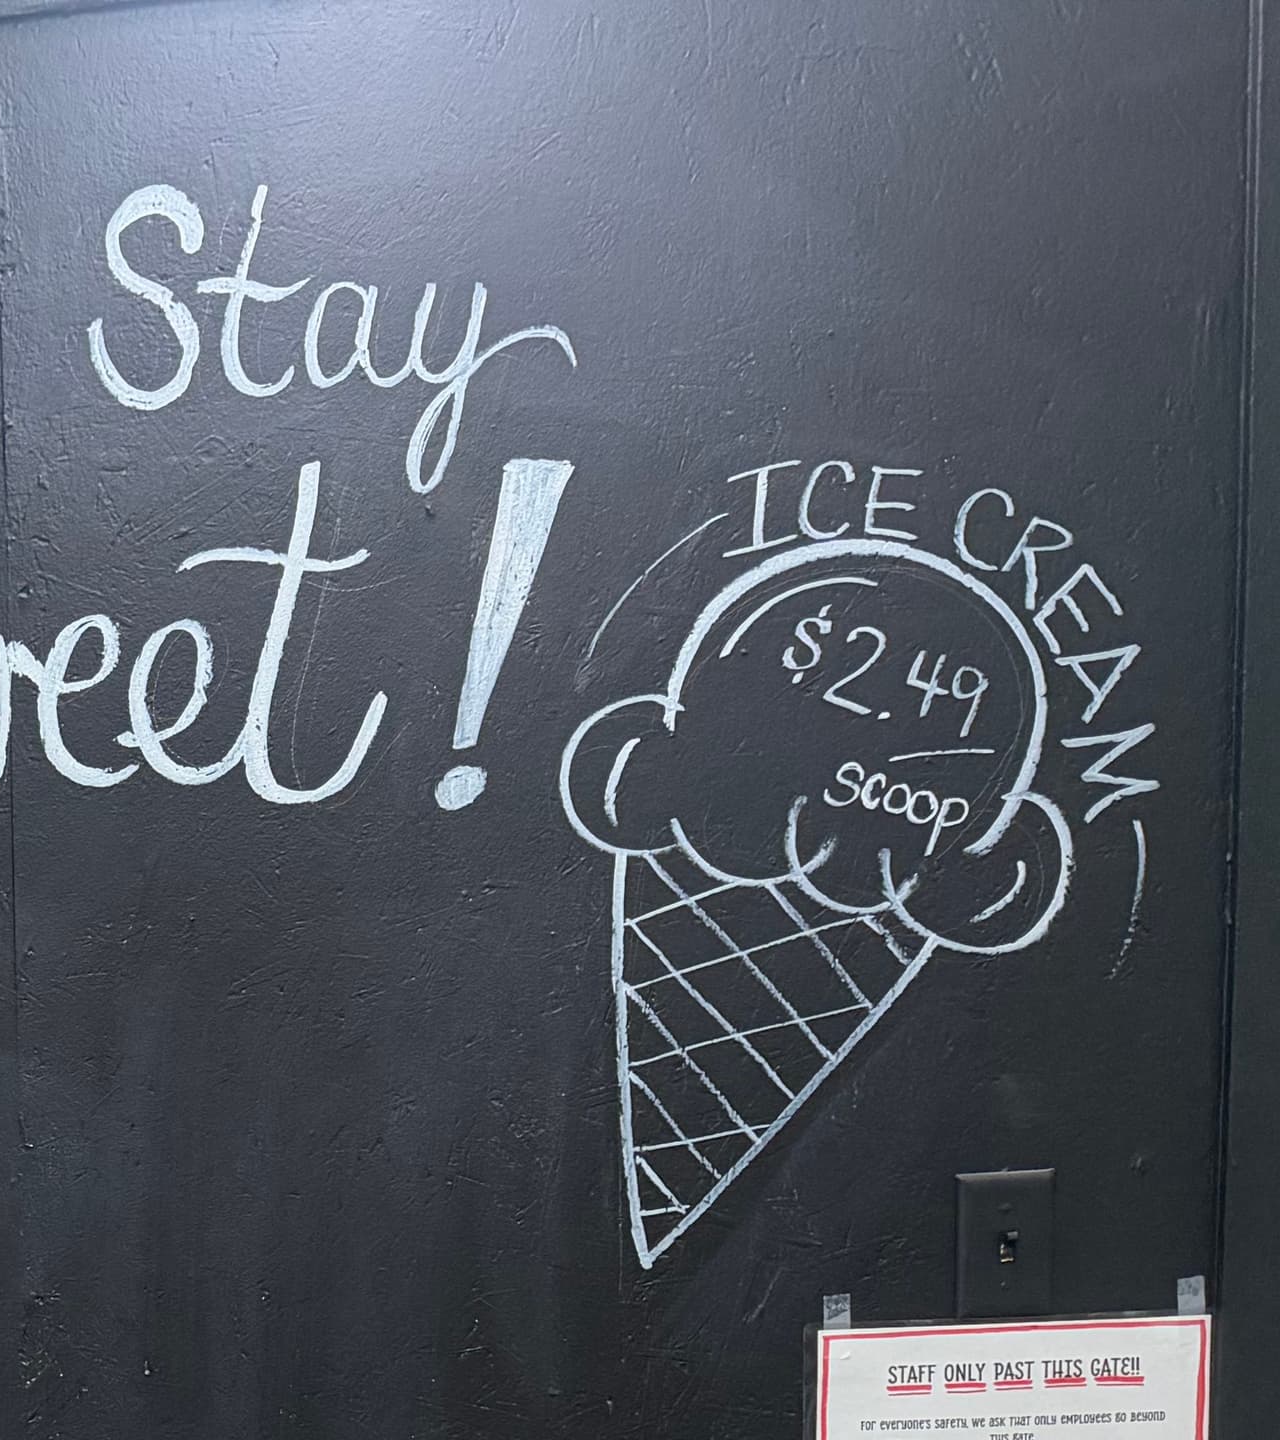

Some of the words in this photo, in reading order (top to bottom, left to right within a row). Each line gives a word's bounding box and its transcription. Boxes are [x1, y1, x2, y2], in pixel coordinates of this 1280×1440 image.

[88, 184, 577, 494] Stay
[723, 459, 923, 558] ICE
[953, 487, 1160, 824] CREAM
[782, 604, 990, 738] $2.49
[888, 1363, 937, 1384] STAFF
[944, 1362, 987, 1382] ONLY
[994, 1360, 1035, 1381] PAST
[1042, 1359, 1083, 1378] THIS
[1091, 1356, 1141, 1376] GATE!!
